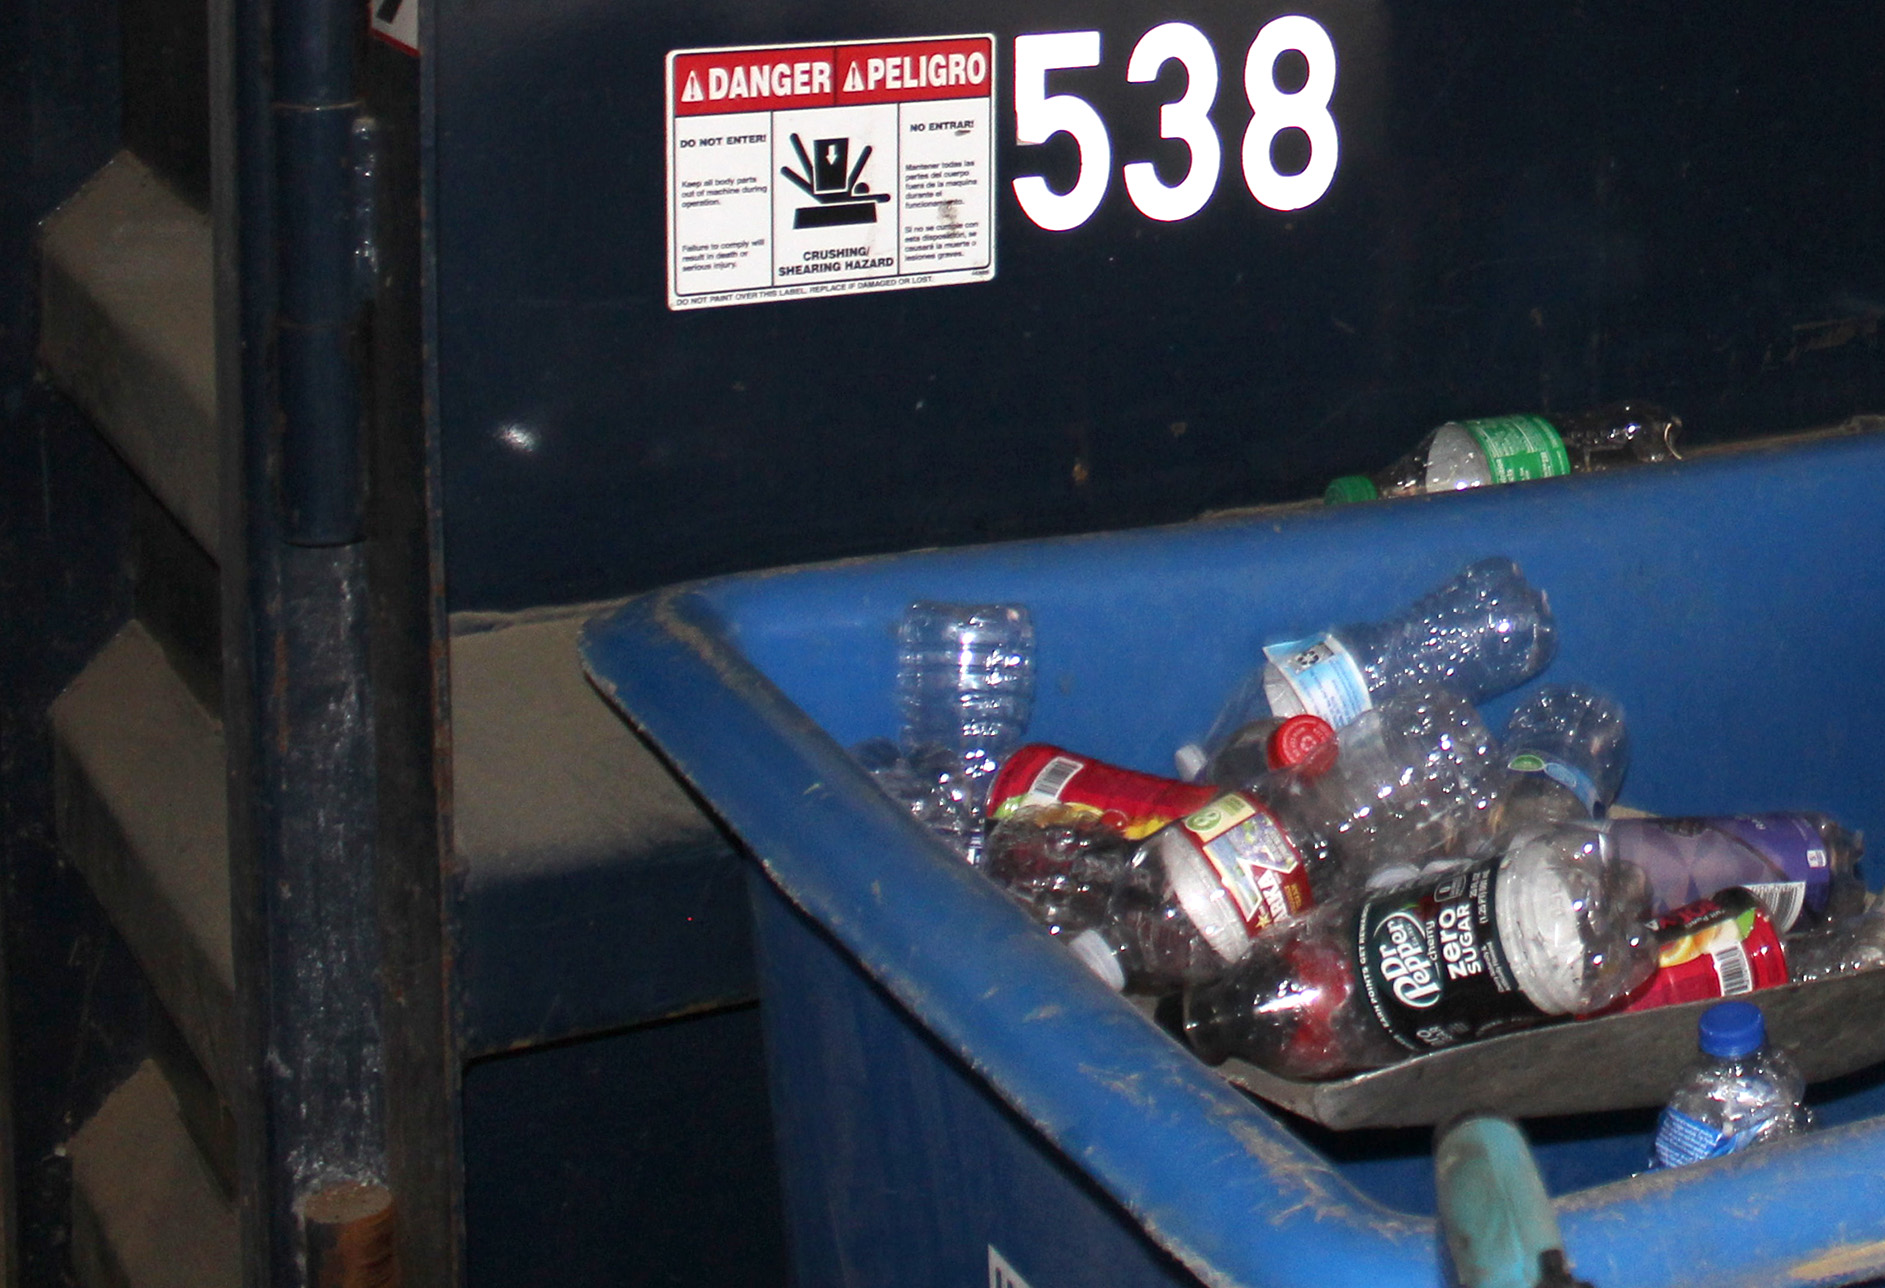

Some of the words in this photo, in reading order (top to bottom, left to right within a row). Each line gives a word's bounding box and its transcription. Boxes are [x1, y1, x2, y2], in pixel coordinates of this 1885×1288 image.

[708, 60, 832, 101] DANGER
[865, 51, 986, 92] PELIGRO
[910, 123, 926, 133] NO
[928, 119, 975, 132] ENTRAR!
[1012, 14, 1340, 232] 538
[680, 139, 696, 149] DO
[699, 137, 723, 148] NOT
[726, 134, 767, 146] ENTER!
[905, 162, 940, 172] Mantener
[941, 161, 962, 169] todas
[681, 180, 702, 190] Keep
[703, 179, 713, 187] all
[715, 177, 734, 187] body
[736, 176, 757, 185] parts
[905, 172, 929, 181] partes
[931, 171, 942, 179] del
[943, 170, 969, 180] cuerpo
[681, 190, 694, 199] out
[696, 189, 706, 197] of
[706, 187, 740, 197] machine
[741, 185, 768, 195] during
[905, 182, 925, 190] fuera
[926, 181, 935, 189] de
[937, 180, 944, 188] la
[905, 191, 933, 200] durante
[935, 190, 942, 198] el
[681, 199, 721, 209] operation.
[905, 235, 921, 243] esta
[968, 230, 977, 238] se
[682, 244, 709, 253] Failure
[711, 242, 719, 251] to
[720, 240, 750, 251] comply
[751, 238, 765, 247] will
[944, 241, 970, 249] muerte
[682, 253, 706, 262] result
[707, 252, 714, 260] in
[716, 250, 738, 260] death
[803, 247, 871, 262] CRUSHING/
[905, 253, 936, 262] lesiones
[937, 250, 964, 260] graves.
[682, 262, 712, 272] serious
[713, 261, 736, 271] injury.
[778, 262, 842, 277] SHEARING
[844, 257, 895, 271] HAZARD
[676, 298, 689, 307] DO
[690, 296, 707, 306] NOT
[709, 293, 734, 303] PAINT
[735, 291, 758, 301] OVER
[759, 289, 778, 299] THIS
[809, 283, 846, 295] REPLACE
[848, 282, 855, 291] IF
[857, 278, 897, 290] DAMAGED
[898, 277, 911, 286] OR
[1425, 920, 1439, 961] cherry
[1456, 903, 1482, 974] SUGAR
[1359, 945, 1367, 964] GET
[1386, 919, 1442, 1004] Pepper
[1378, 943, 1397, 982] Dr
[1361, 966, 1379, 1005] POINTS
[1374, 1005, 1389, 1028] EARN
